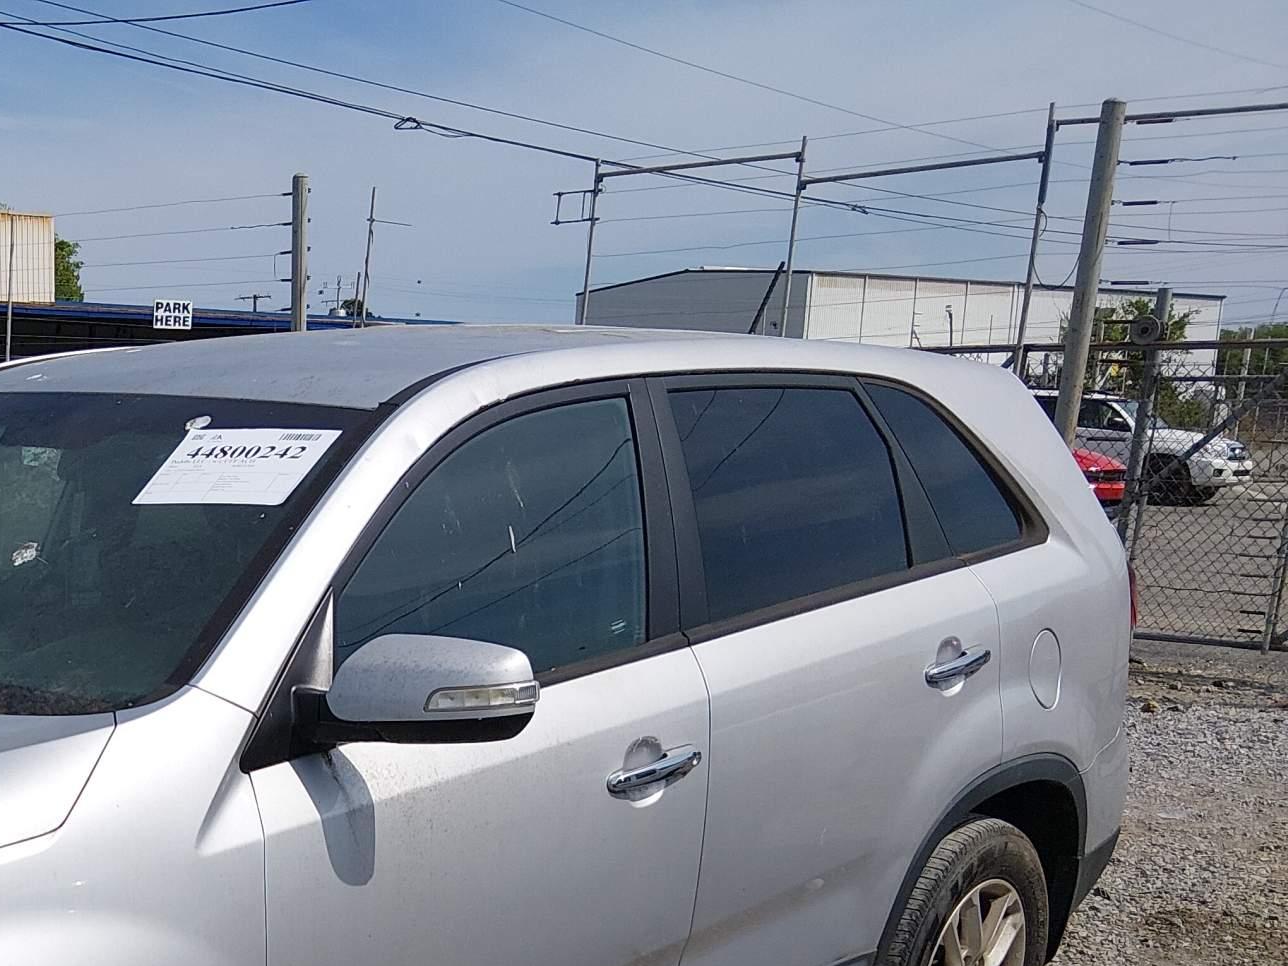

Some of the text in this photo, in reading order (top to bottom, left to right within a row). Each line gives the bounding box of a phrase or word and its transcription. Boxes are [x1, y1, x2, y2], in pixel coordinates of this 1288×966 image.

[155, 302, 191, 314] PARK
[154, 315, 190, 327] HERE
[187, 446, 307, 459] 44800242
